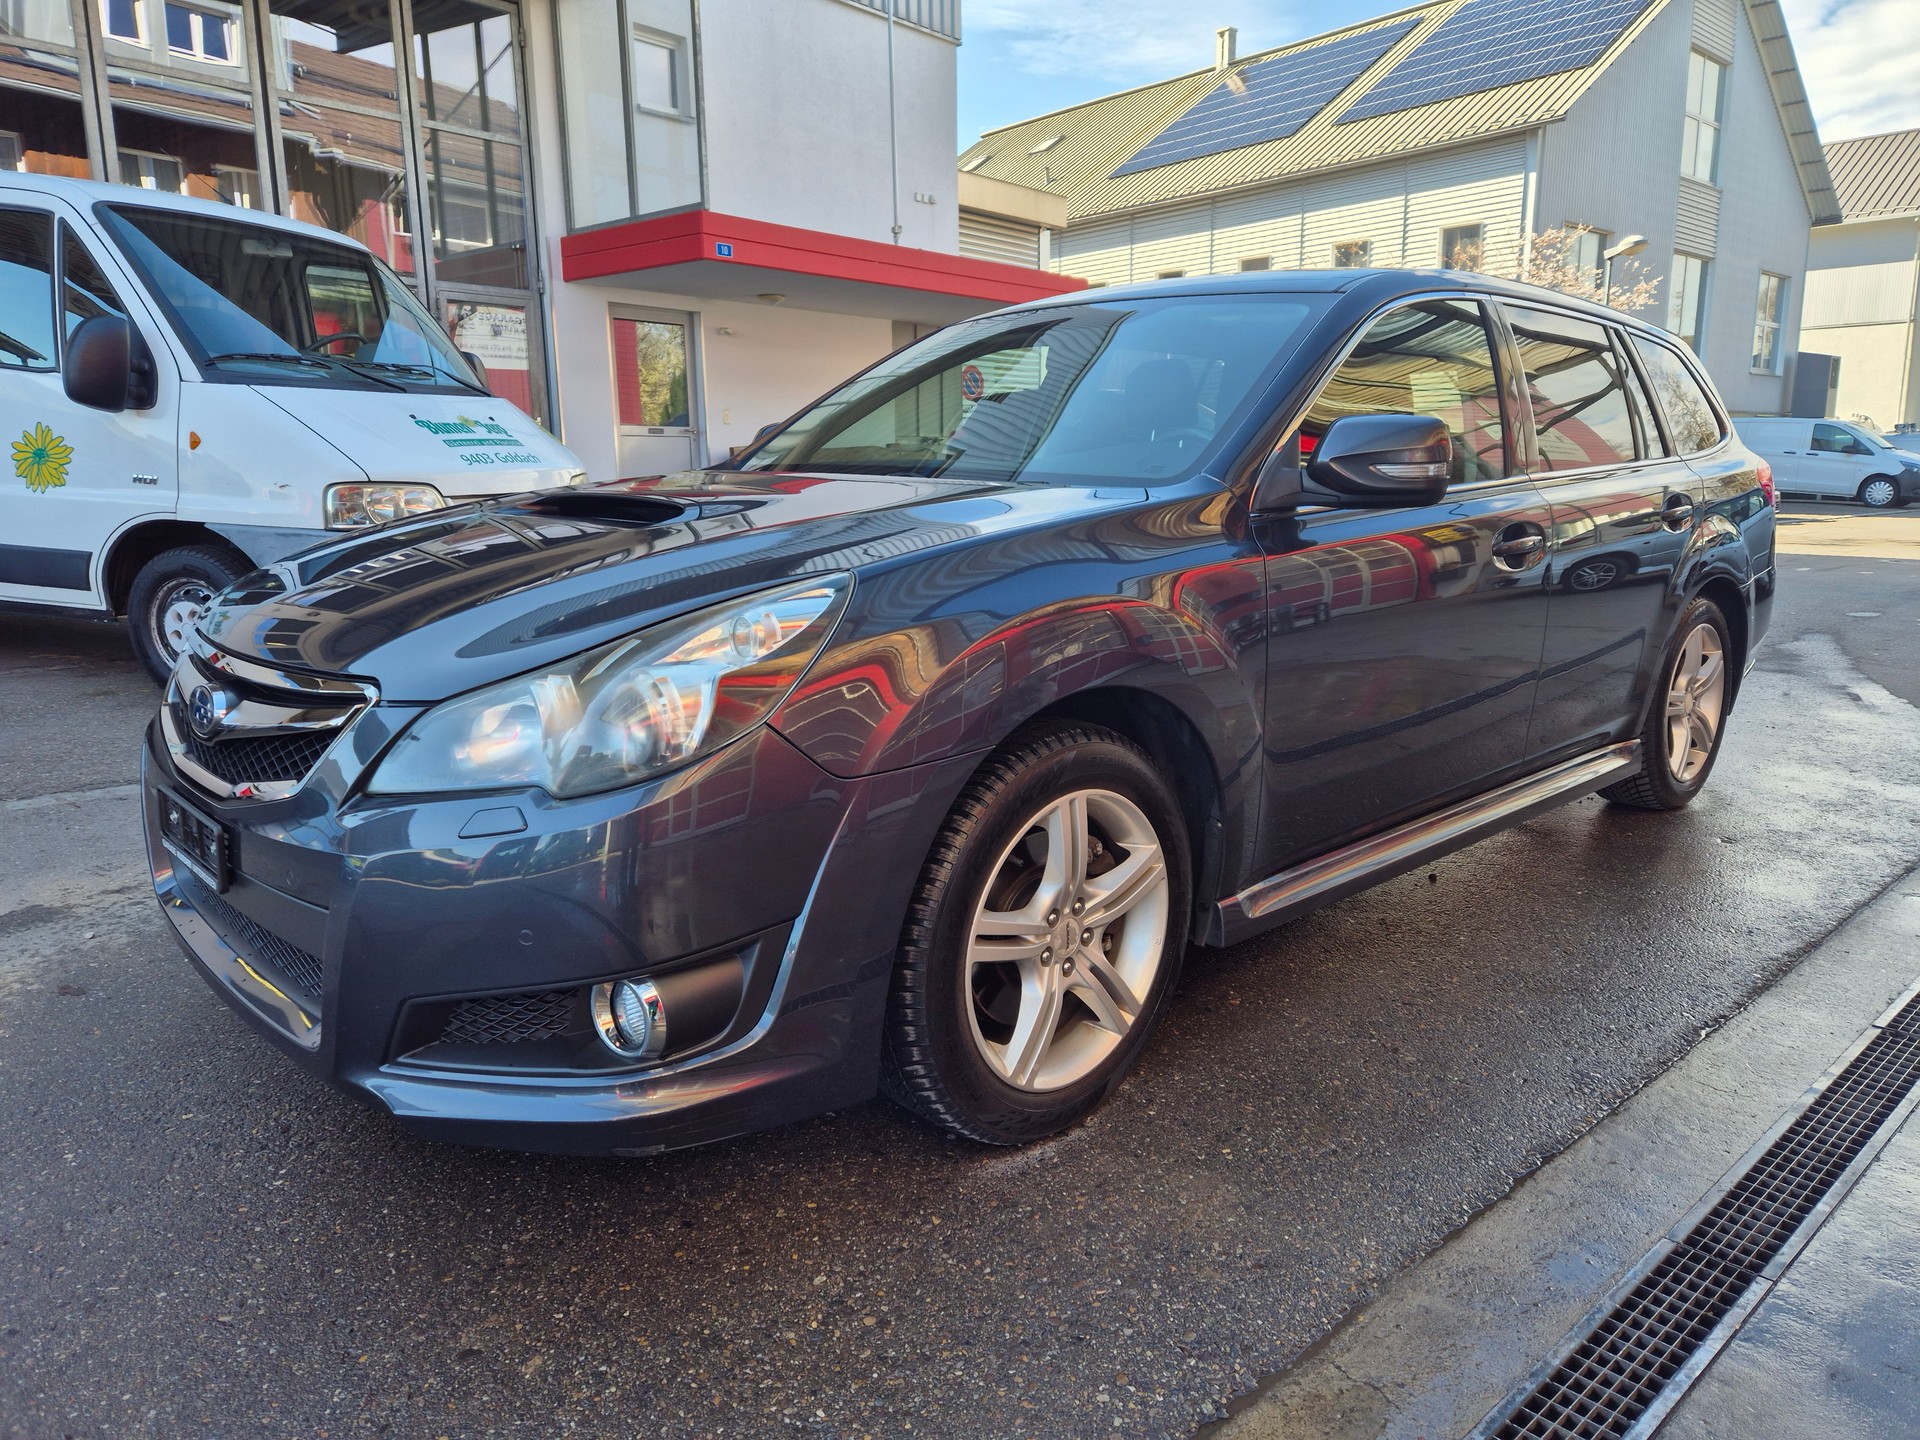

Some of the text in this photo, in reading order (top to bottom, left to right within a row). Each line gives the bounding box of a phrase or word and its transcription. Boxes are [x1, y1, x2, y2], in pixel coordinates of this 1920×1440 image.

[721, 246, 728, 255] 10
[414, 419, 476, 435] Blumen
[460, 452, 541, 466] 9403 Goldach
